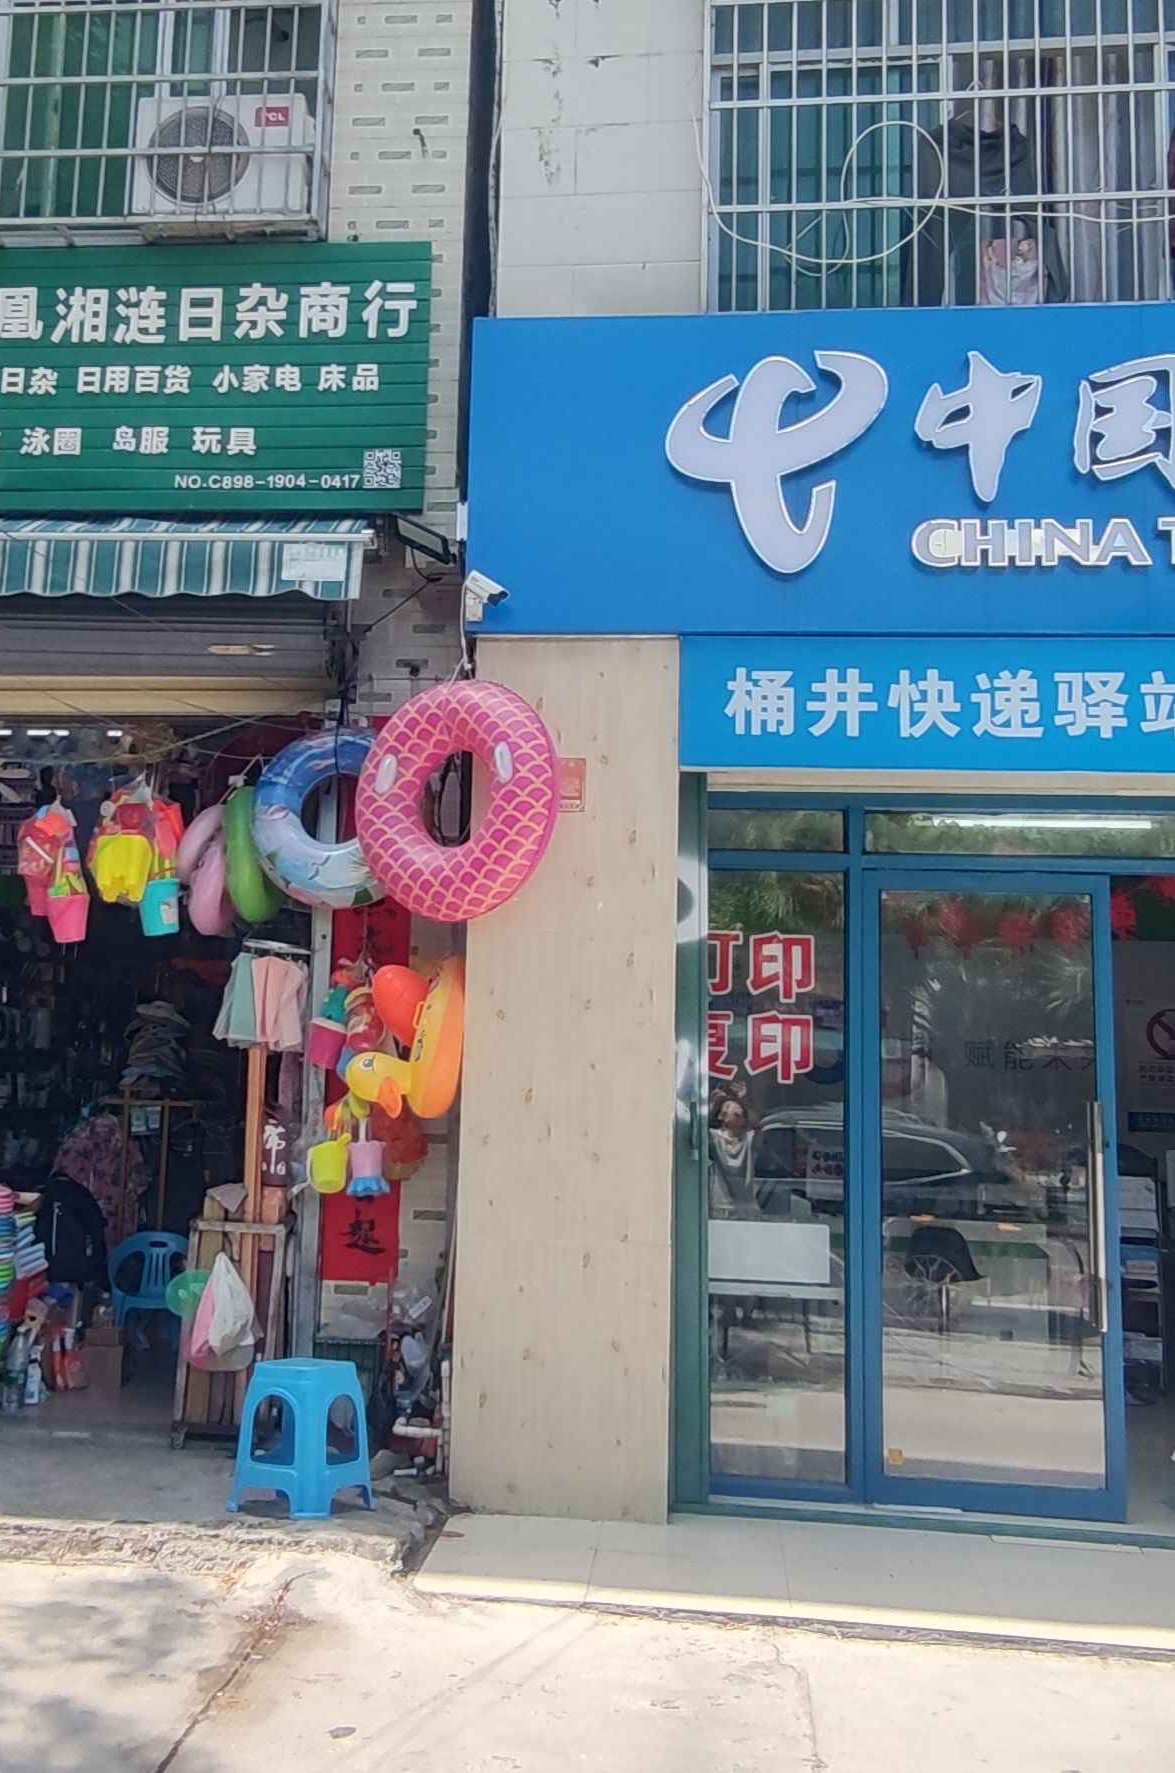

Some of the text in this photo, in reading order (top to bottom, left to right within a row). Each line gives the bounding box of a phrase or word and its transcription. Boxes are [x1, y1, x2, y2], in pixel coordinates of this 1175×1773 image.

[77, 364, 192, 395] 日用百货
[212, 364, 302, 394] 小家电
[318, 363, 381, 392] 床品
[20, 427, 82, 456] 泳圈
[112, 426, 170, 455] 岛服
[192, 427, 257, 456] 玩具
[174, 473, 361, 490] NO.C898-1904-0417
[911, 518, 1153, 567] CHINA
